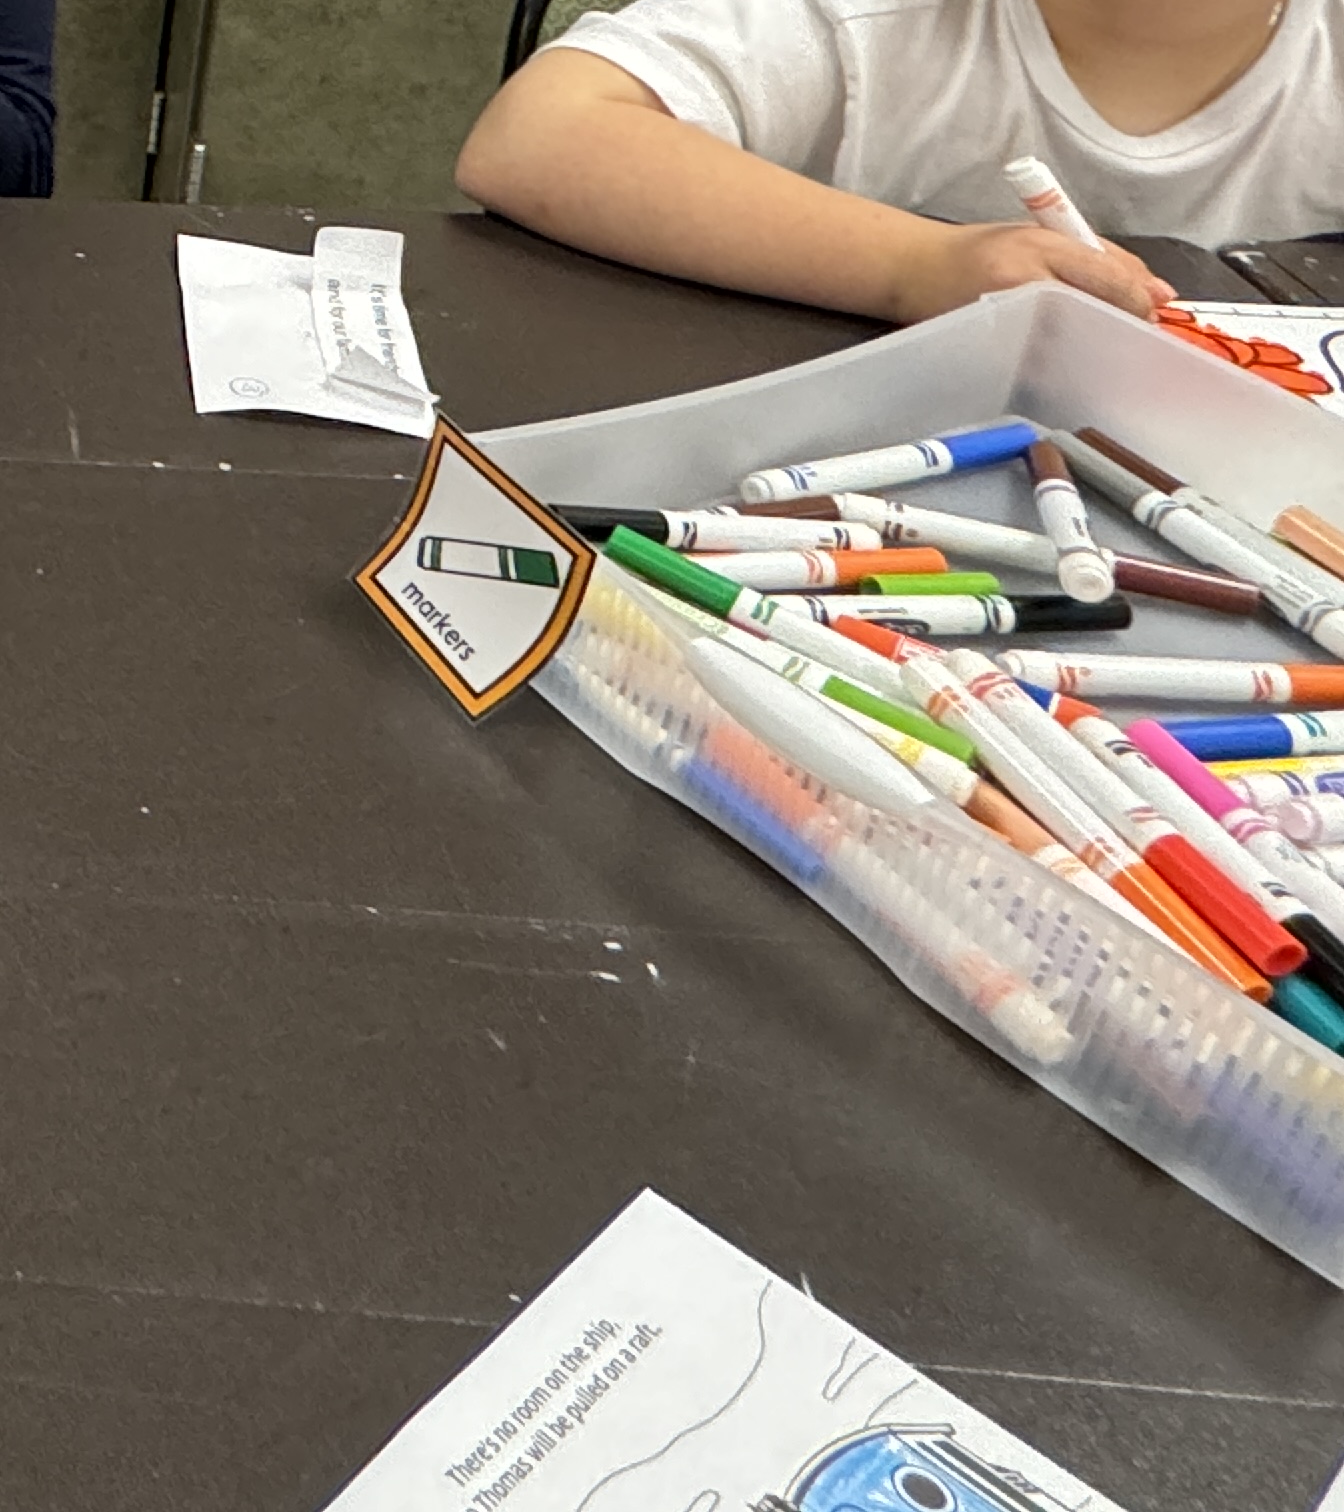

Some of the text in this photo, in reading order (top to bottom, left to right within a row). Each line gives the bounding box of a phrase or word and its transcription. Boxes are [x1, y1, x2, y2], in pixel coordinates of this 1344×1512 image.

[400, 581, 476, 662] markers
[444, 1318, 623, 1488] There's no room on the ship,
[472, 1322, 664, 1512] Thomas will be pulled on a raft.
